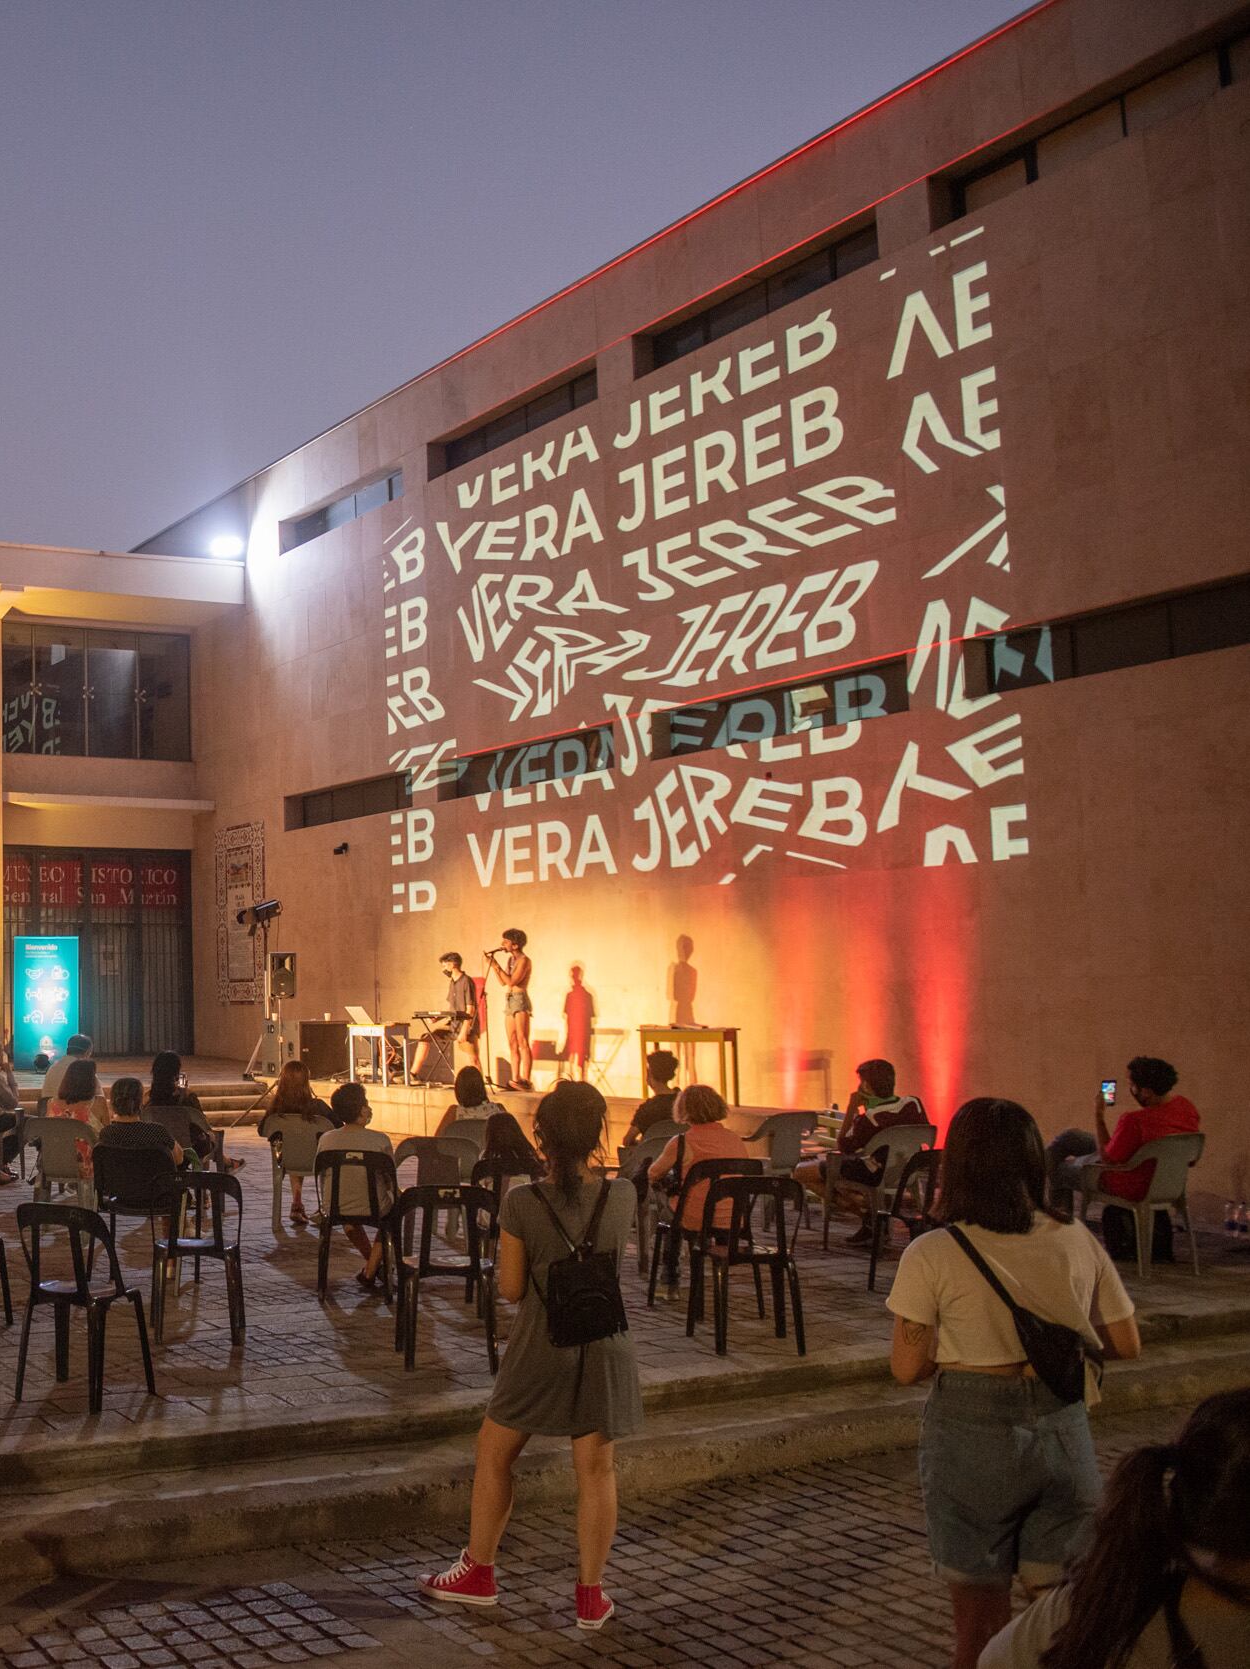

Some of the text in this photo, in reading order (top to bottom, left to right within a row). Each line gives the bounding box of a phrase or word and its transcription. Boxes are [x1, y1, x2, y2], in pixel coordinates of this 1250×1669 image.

[436, 487, 605, 575] VERA
[616, 385, 844, 533] JEREB
[456, 572, 631, 664] VERA
[622, 559, 881, 688] JEREB
[74, 866, 177, 885] HISTOICO
[466, 814, 619, 889] VERA
[631, 763, 868, 874] JEREB
[3, 886, 63, 905] Genral
[77, 886, 106, 906] Sn
